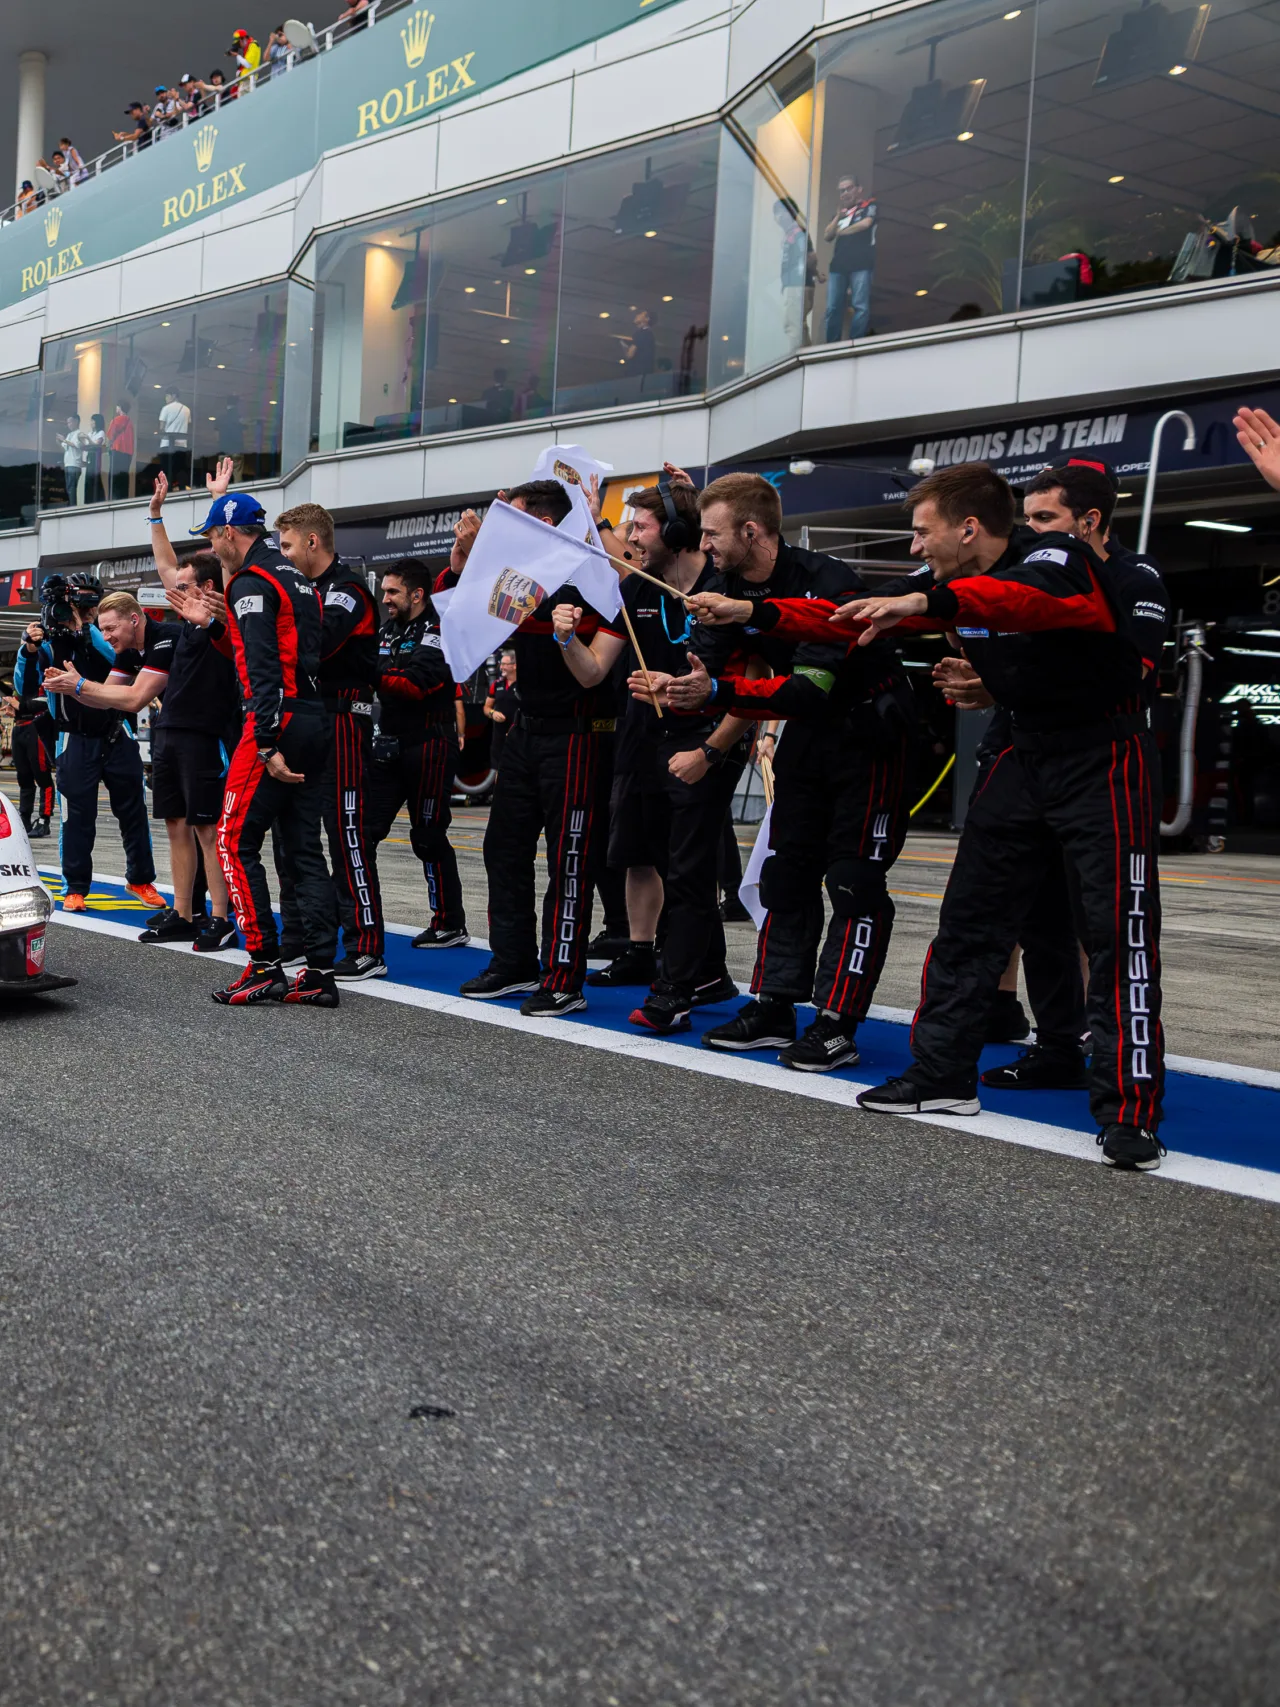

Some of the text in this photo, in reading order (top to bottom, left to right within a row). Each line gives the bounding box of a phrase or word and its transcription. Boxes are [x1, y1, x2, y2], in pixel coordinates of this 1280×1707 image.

[356, 51, 477, 138] ROLEX
[162, 163, 247, 228] ROLEX
[21, 241, 84, 293] ROLEX
[910, 413, 1128, 468] AKKODIS ASP TEAM
[1115, 461, 1152, 473] LOPEZ
[1020, 463, 1050, 472] LMGT
[883, 491, 909, 500] TAKE
[386, 511, 460, 540] AKKODIS ASP
[137, 555, 158, 573] RACIN
[344, 790, 375, 926] PORSCHE
[558, 810, 585, 964] PORSCHE
[1128, 854, 1152, 1080] PORSCHE
